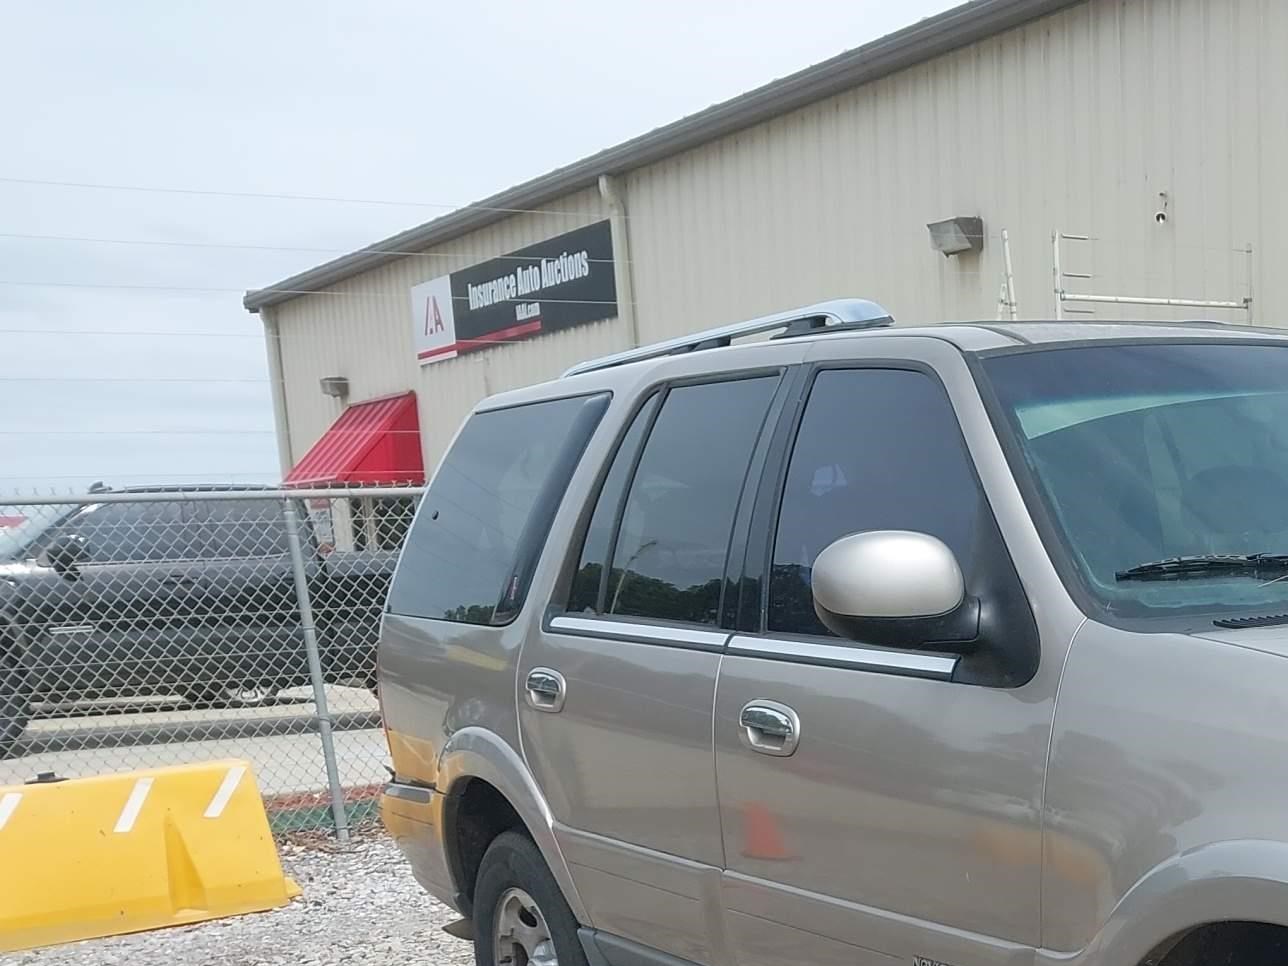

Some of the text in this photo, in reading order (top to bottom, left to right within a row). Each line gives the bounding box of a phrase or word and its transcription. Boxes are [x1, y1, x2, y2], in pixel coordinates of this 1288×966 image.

[468, 250, 590, 311] Insurance Auto Auctions
